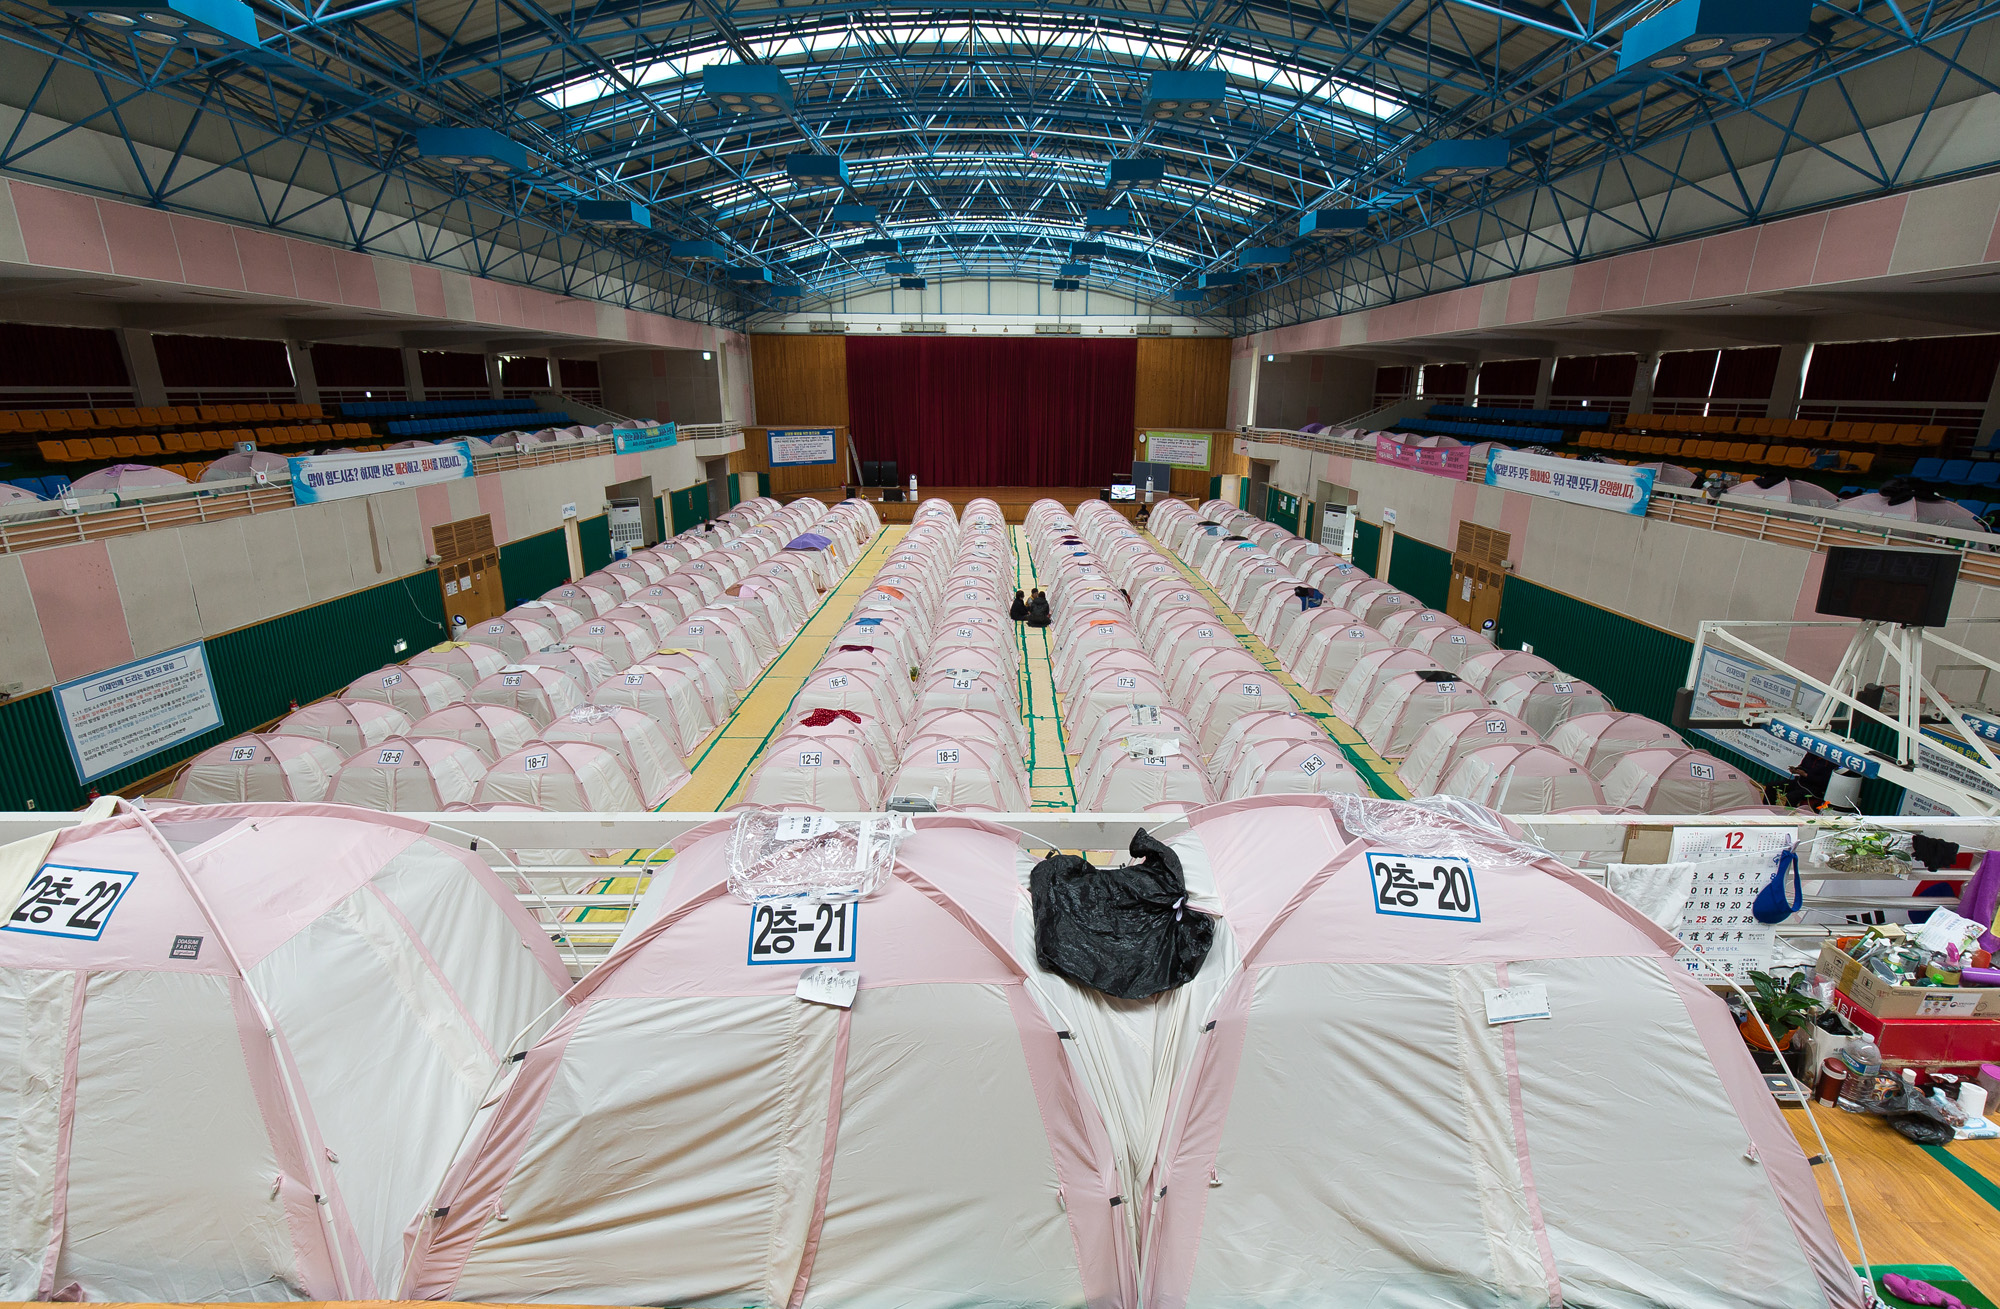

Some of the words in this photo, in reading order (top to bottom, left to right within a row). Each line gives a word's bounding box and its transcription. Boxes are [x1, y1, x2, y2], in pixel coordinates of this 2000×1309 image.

[307, 472, 324, 488] 많이
[325, 467, 358, 486] 힘드시죠?
[360, 465, 381, 479] 하지만
[382, 464, 395, 476] 서로
[395, 459, 421, 475] 배려하고,
[421, 458, 439, 472] 질서를
[439, 455, 461, 469] 지킵시다.
[1494, 462, 1508, 476] 여러분
[1509, 466, 1518, 479] 모두
[1519, 467, 1529, 480] 모두
[1530, 469, 1552, 484] 힘내세요.
[1553, 472, 1565, 487] 우리
[1565, 474, 1578, 490] 국민
[1579, 477, 1598, 492] 모두가
[1599, 480, 1634, 499] 응원합니다.
[98, 679, 123, 692] 이재민께
[125, 673, 143, 683] 드리는
[144, 666, 162, 677] 협조의
[163, 662, 174, 670] 말씀
[1726, 667, 1746, 679] 이재민께
[384, 674, 401, 686] 16-9
[505, 676, 521, 685] 16-8
[627, 675, 642, 684] 16-7
[831, 677, 847, 686] 16-6
[956, 680, 969, 688] 4-8
[1119, 679, 1134, 687] 17-5
[1245, 686, 1260, 694] 16-3
[1438, 683, 1455, 691] 16-2
[1555, 684, 1571, 692] 16-1
[1488, 721, 1505, 732] 17-2
[1985, 725, 1999, 738] 동
[233, 749, 253, 759] 18-9
[382, 752, 401, 762] 18-8
[939, 751, 957, 761] 18-5
[527, 756, 547, 768] 18-7
[802, 755, 820, 765] 12-6
[1304, 757, 1322, 772] 18-3
[1693, 765, 1711, 778] 18-1
[1725, 832, 1744, 849] 12
[1375, 862, 1471, 913] 2층-20
[1704, 887, 1713, 895] 11
[1719, 887, 1728, 895] 12
[1734, 887, 1744, 895] 13
[1750, 887, 1759, 895] 14
[10, 875, 122, 929] 2층-22
[753, 903, 847, 955] 2층-21
[1689, 931, 1744, 942] 謹賀新年
